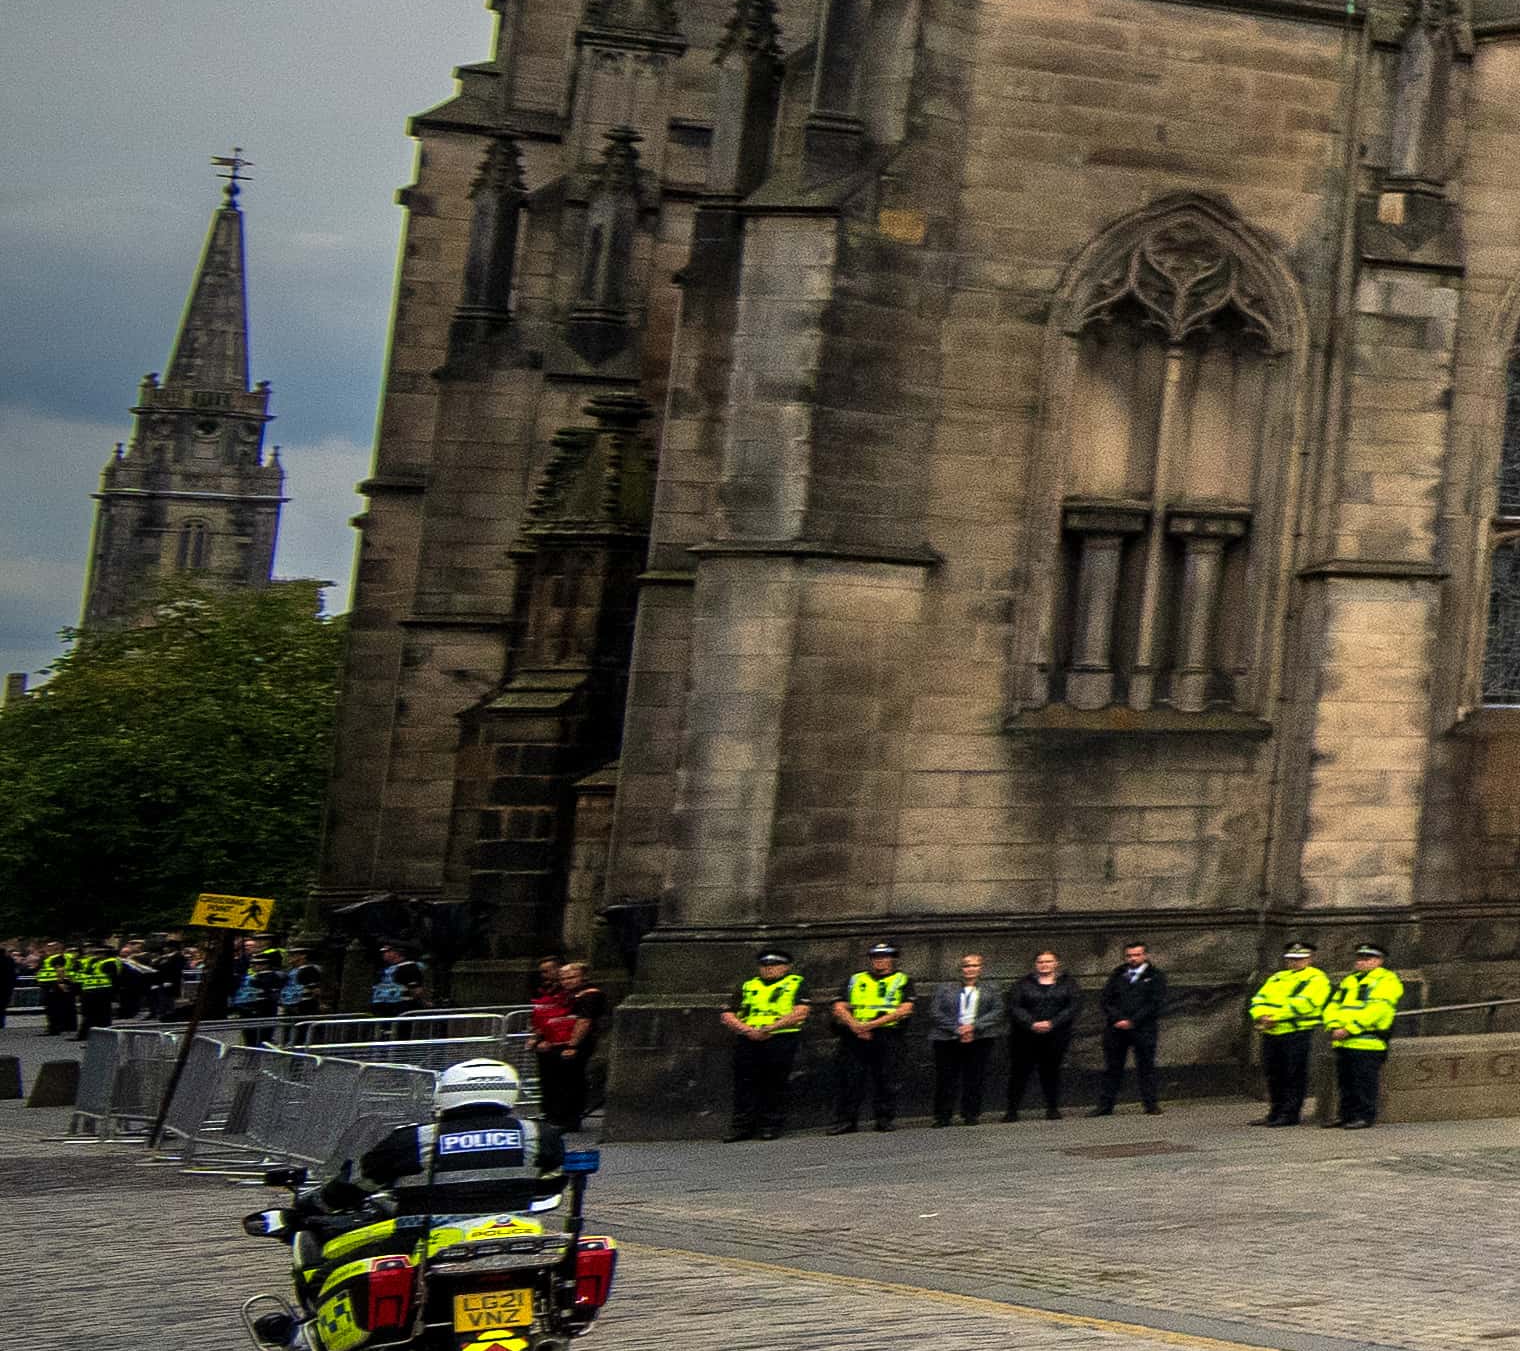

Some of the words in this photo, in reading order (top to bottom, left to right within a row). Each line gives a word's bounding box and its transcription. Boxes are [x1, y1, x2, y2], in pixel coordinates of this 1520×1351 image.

[1416, 1057, 1465, 1082] ST
[445, 1132, 520, 1150] POLICE
[471, 1228, 534, 1238] POLICE
[463, 1293, 525, 1312] LG21
[468, 1309, 520, 1327] VNZ
